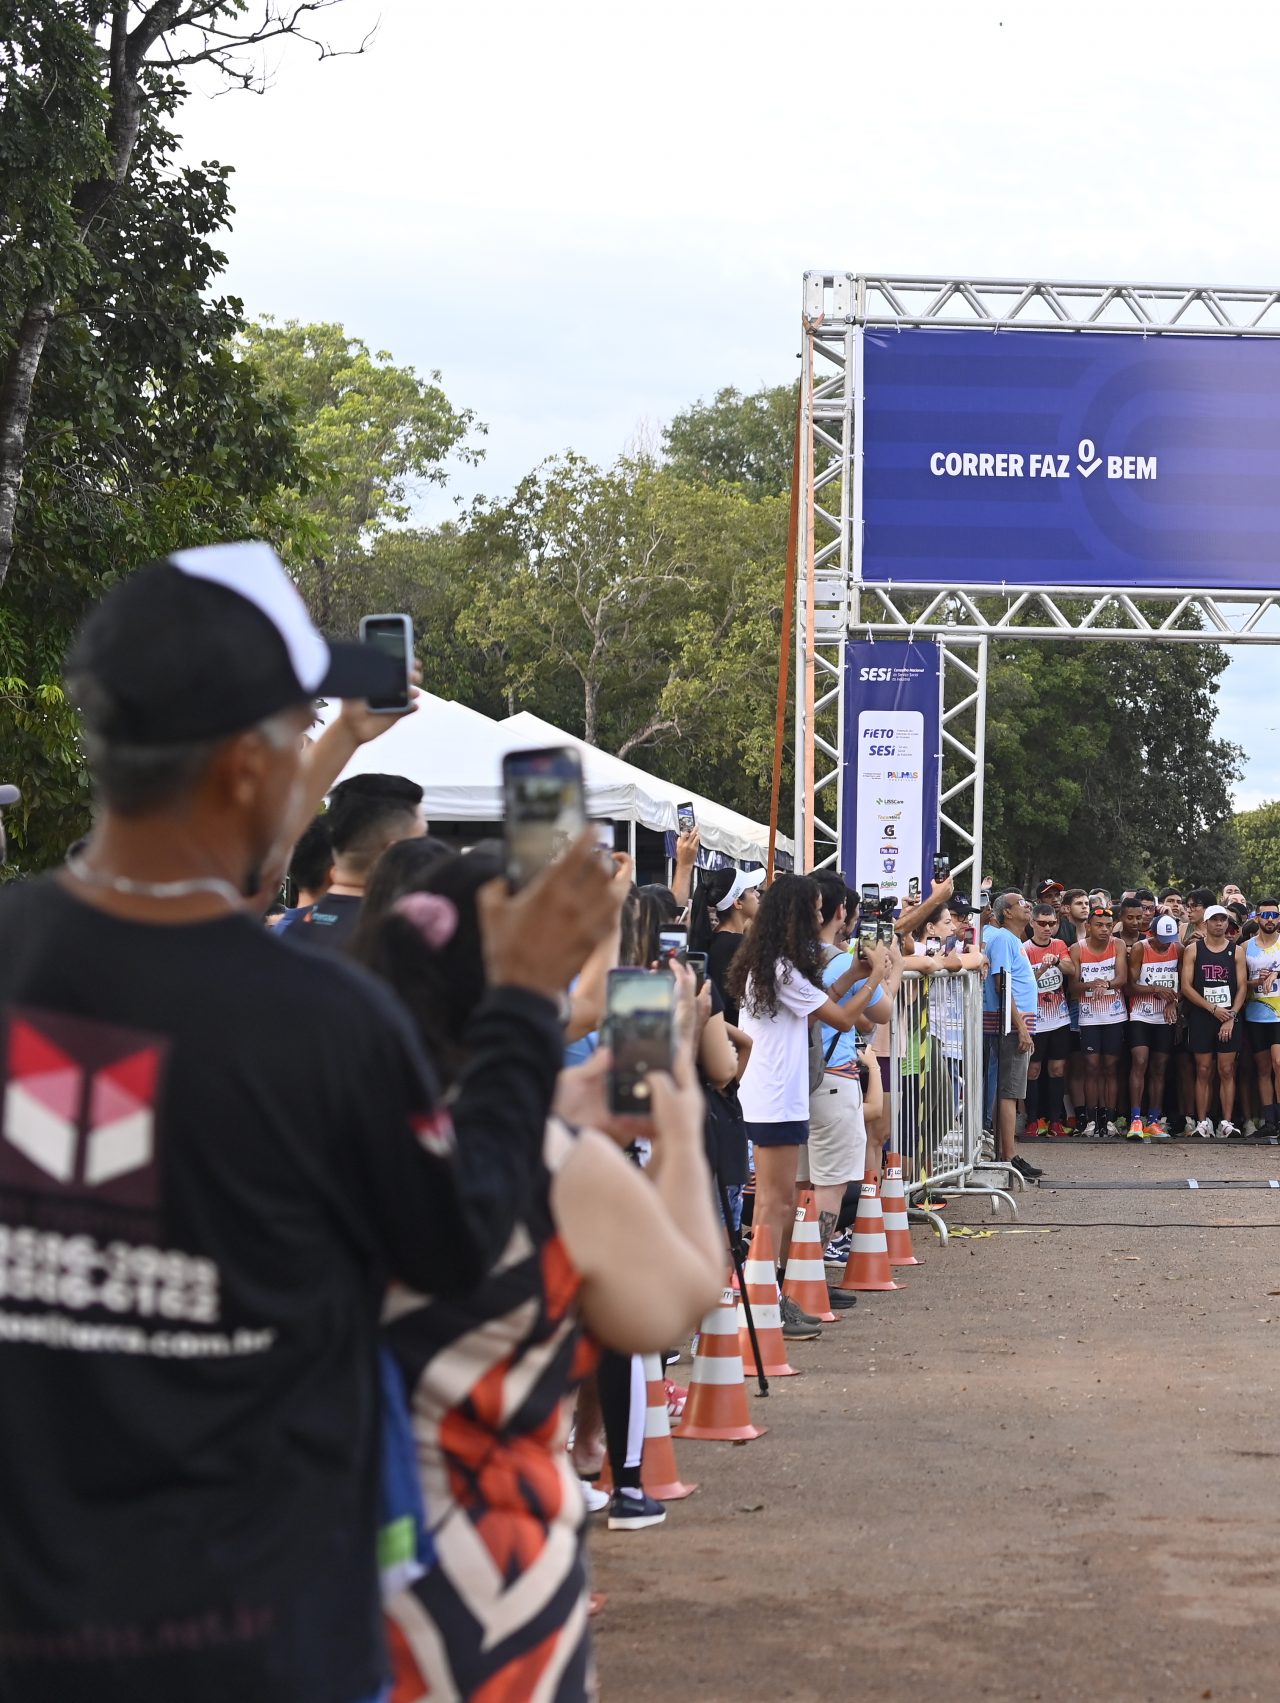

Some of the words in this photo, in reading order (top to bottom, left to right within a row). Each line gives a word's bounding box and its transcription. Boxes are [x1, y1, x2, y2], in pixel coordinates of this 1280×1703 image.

[930, 452, 1024, 477] CORRER
[1029, 454, 1070, 478] FAZ
[1107, 455, 1157, 480] BEM
[887, 771, 919, 779] PALMAS
[1038, 976, 1060, 988] 1058
